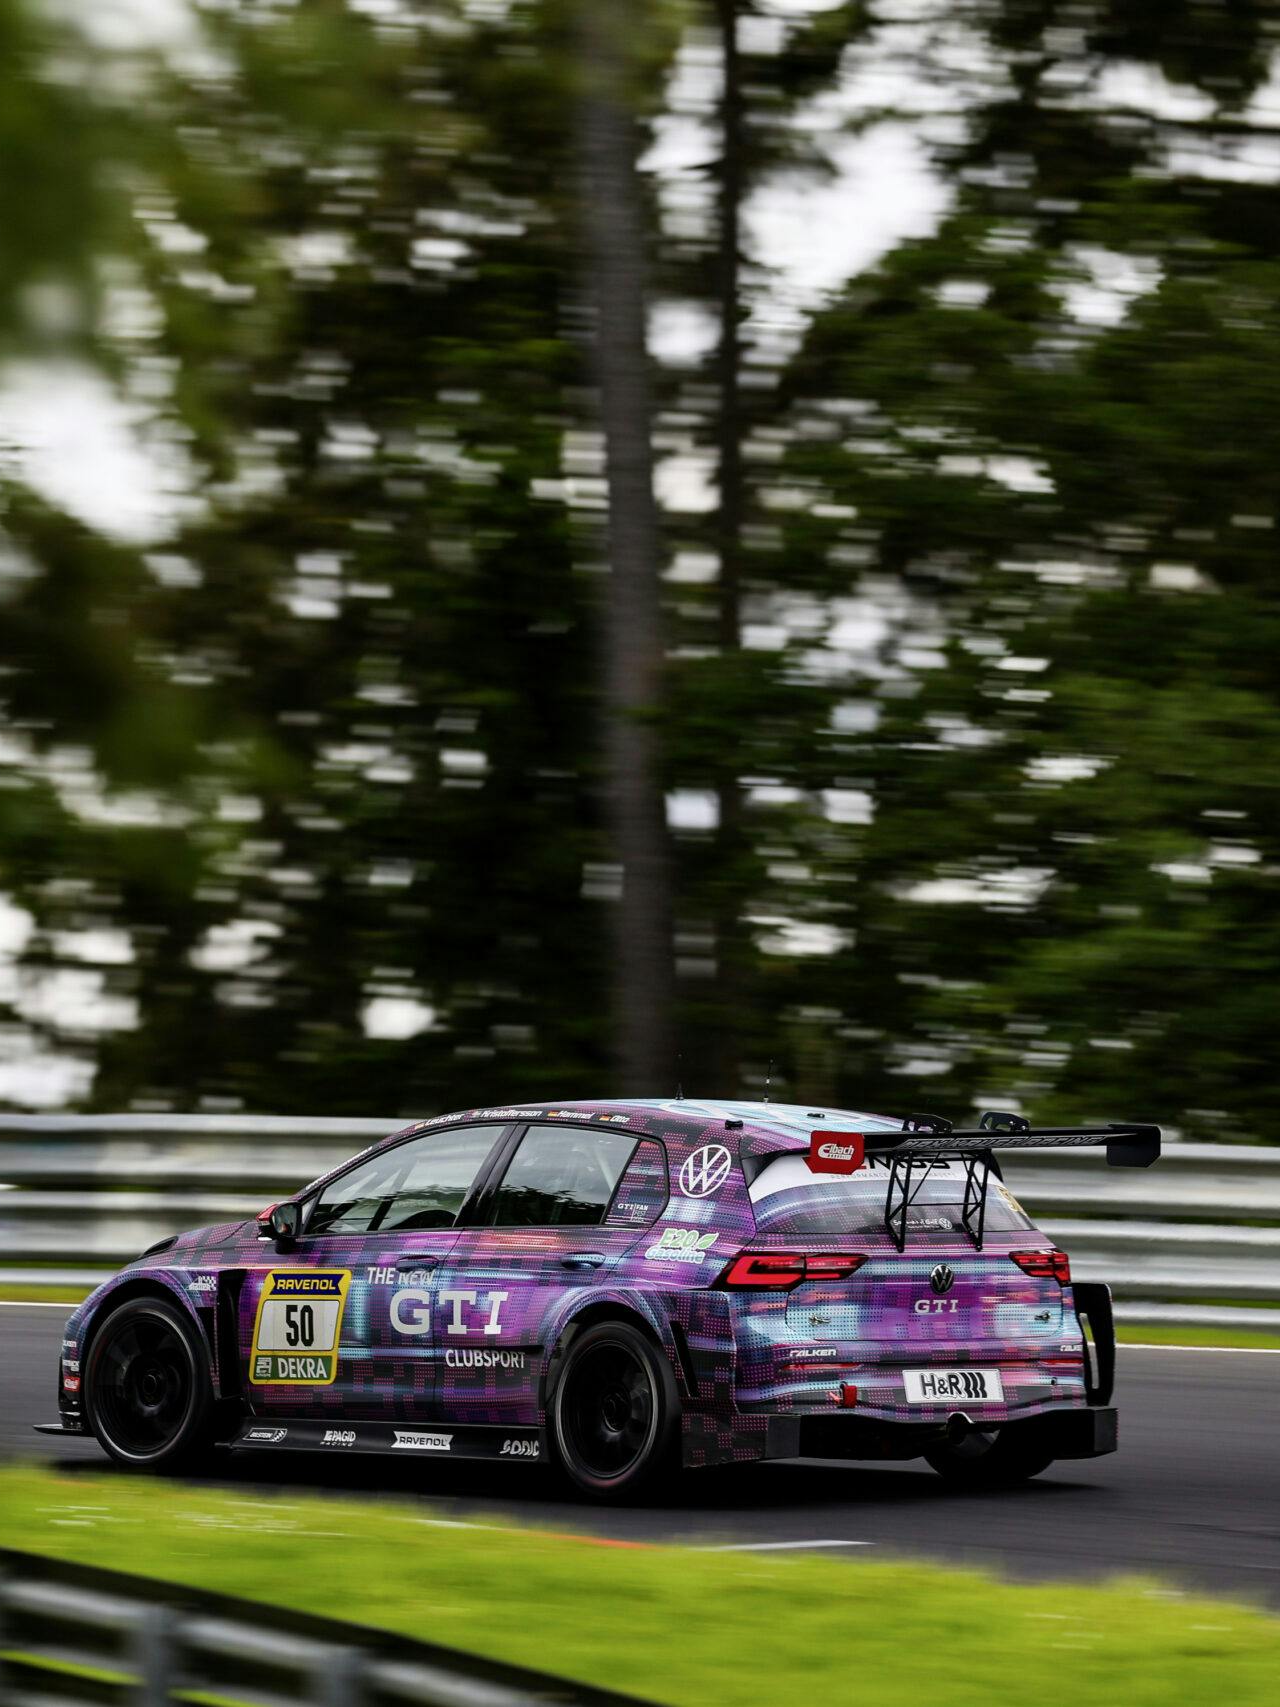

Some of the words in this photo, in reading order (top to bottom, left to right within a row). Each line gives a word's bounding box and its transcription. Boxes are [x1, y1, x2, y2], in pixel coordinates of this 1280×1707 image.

[557, 1110, 595, 1120] Hammel
[610, 1115, 630, 1123] Otto
[818, 1143, 855, 1160] Eibach
[661, 1228, 699, 1249] E20
[367, 1267, 396, 1285] THE
[276, 1279, 336, 1291] RAVENOL
[389, 1288, 509, 1335] GTI
[914, 1299, 959, 1314] GTI
[285, 1304, 315, 1347] 50
[445, 1349, 526, 1369] CLUBSPORT
[790, 1348, 837, 1357] FALKEN
[277, 1357, 328, 1379] DEKRA
[920, 1373, 964, 1397] H&R
[399, 1436, 448, 1447] RAVENOL
